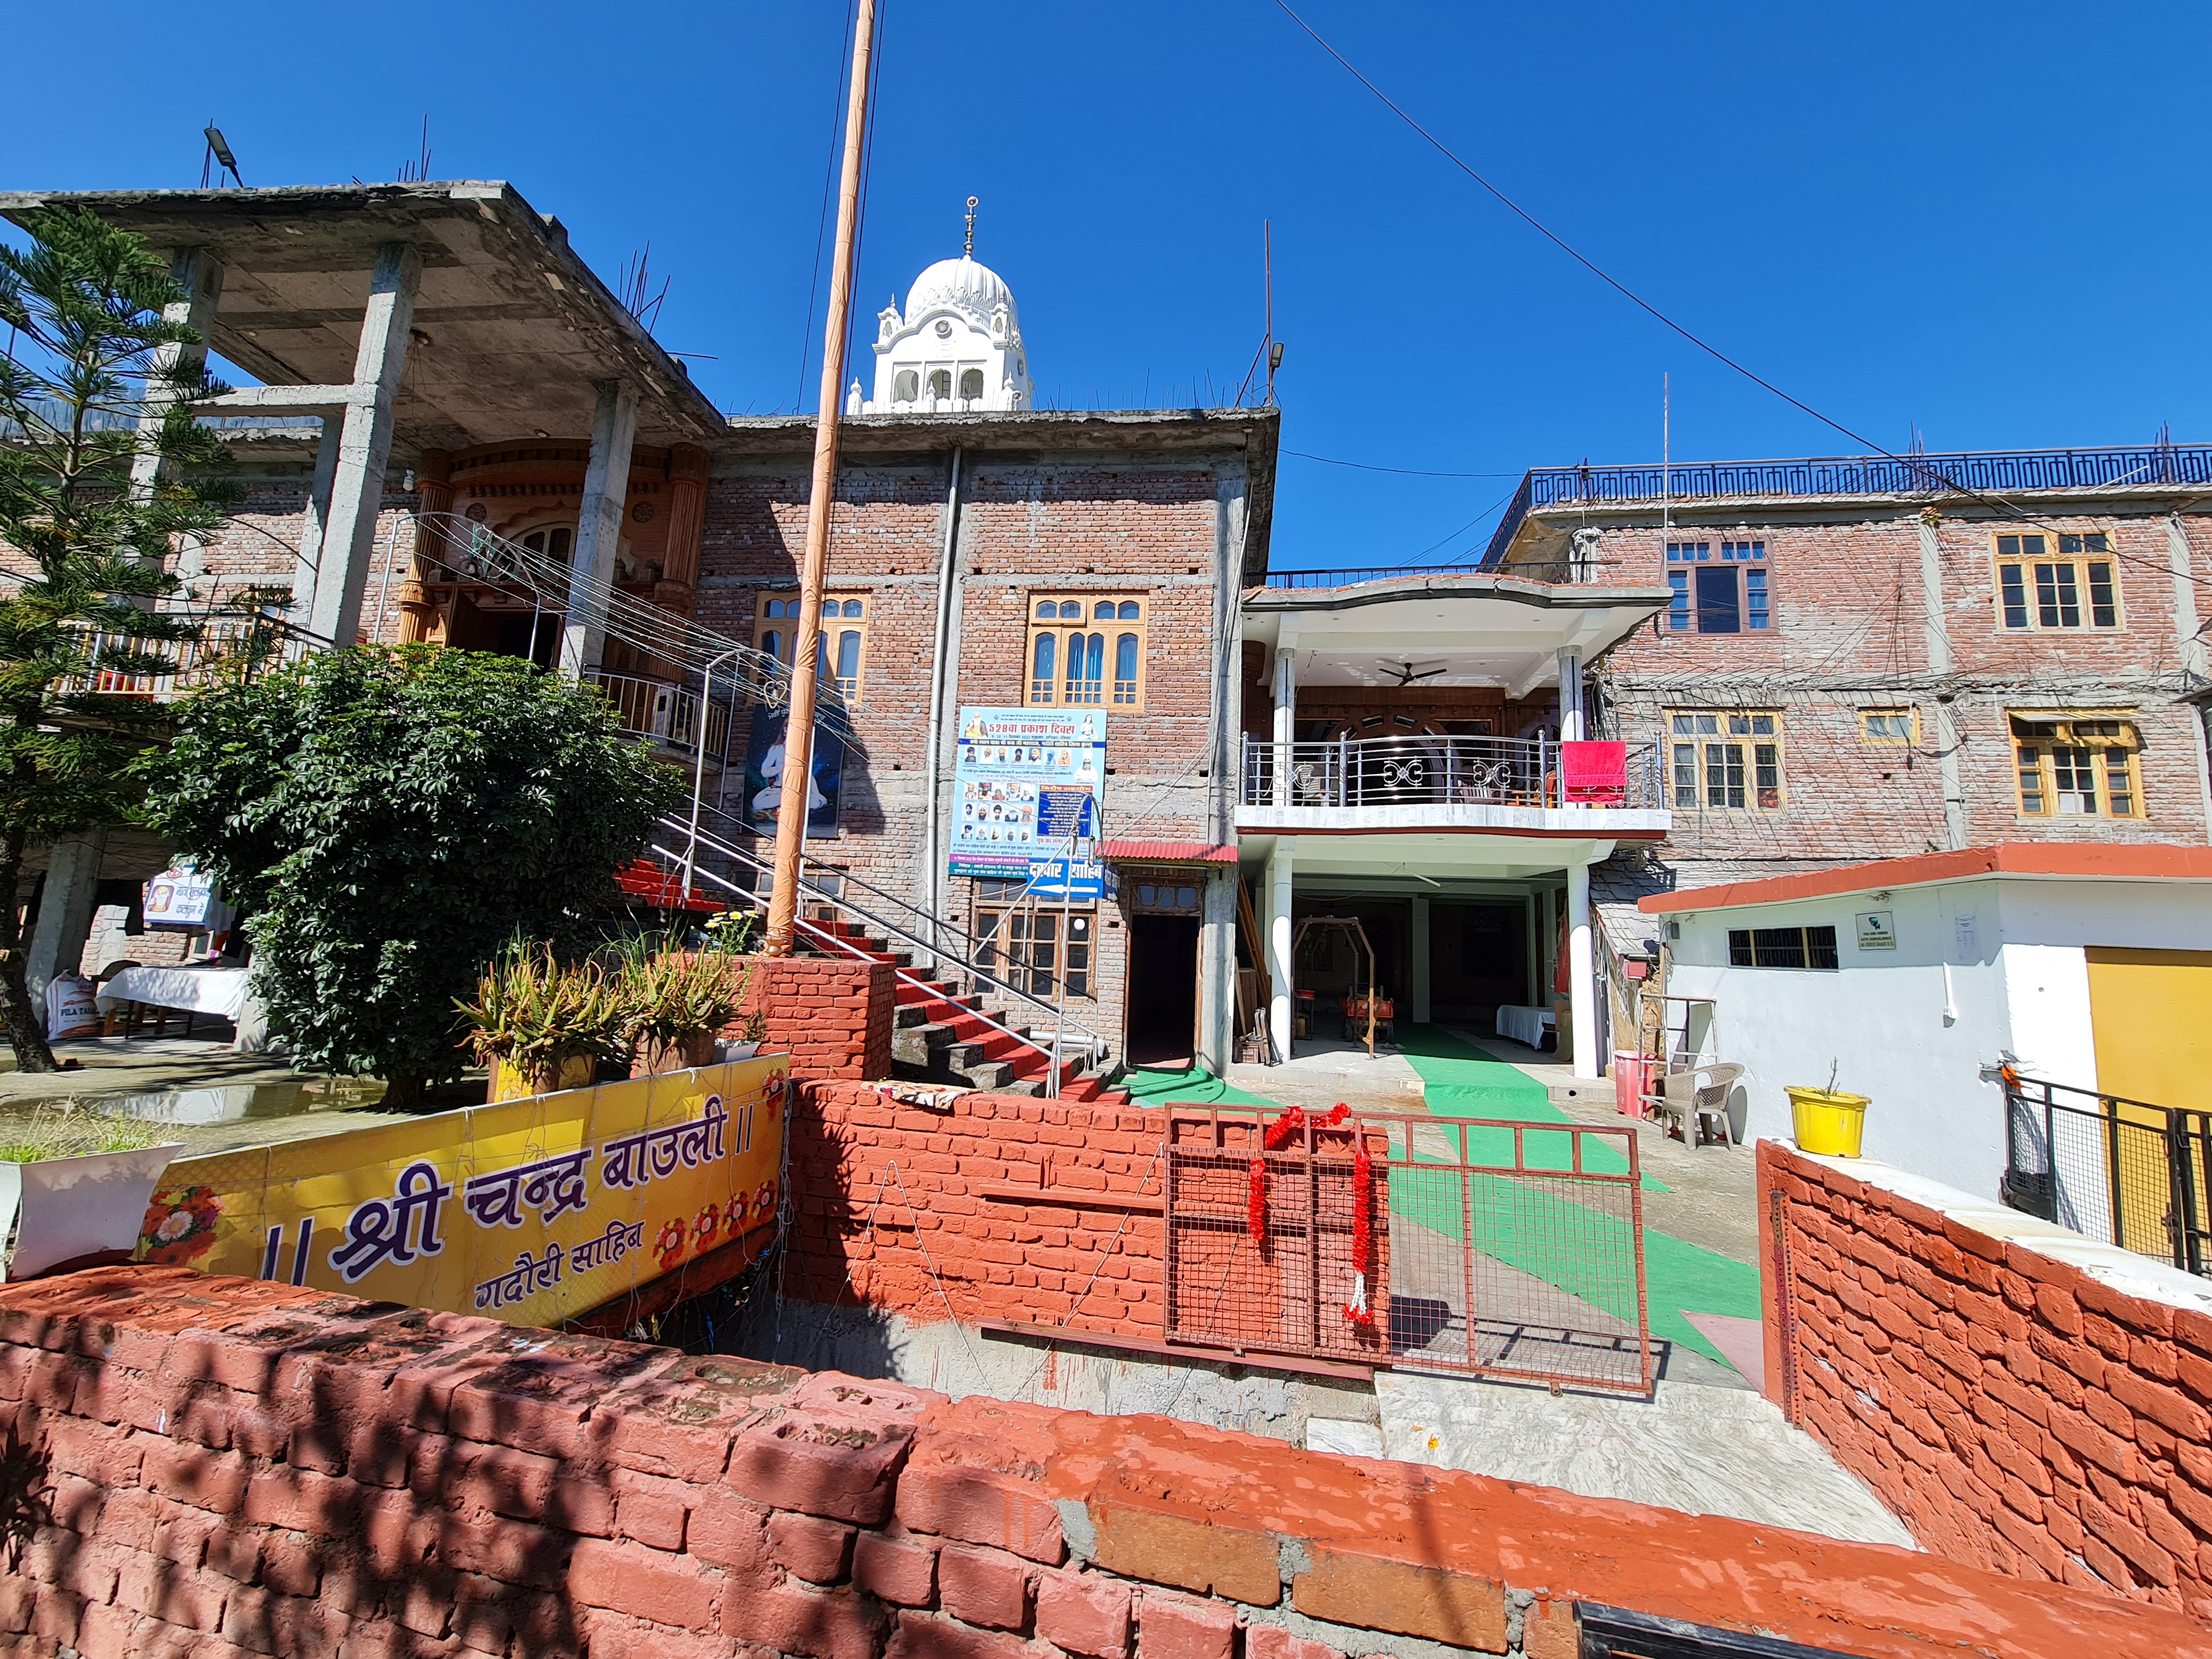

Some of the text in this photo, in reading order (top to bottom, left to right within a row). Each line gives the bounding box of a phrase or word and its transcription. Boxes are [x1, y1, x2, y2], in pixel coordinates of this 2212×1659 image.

[1021, 724, 1048, 734] प्रकाश
[1051, 723, 1075, 734] दिवस
[1071, 860, 1104, 879] साहिब
[330, 1161, 452, 1281] श्री
[466, 1149, 592, 1227] चन्द्र
[601, 1094, 729, 1189] बाउली
[475, 1220, 645, 1310] गदौरी साहिब
